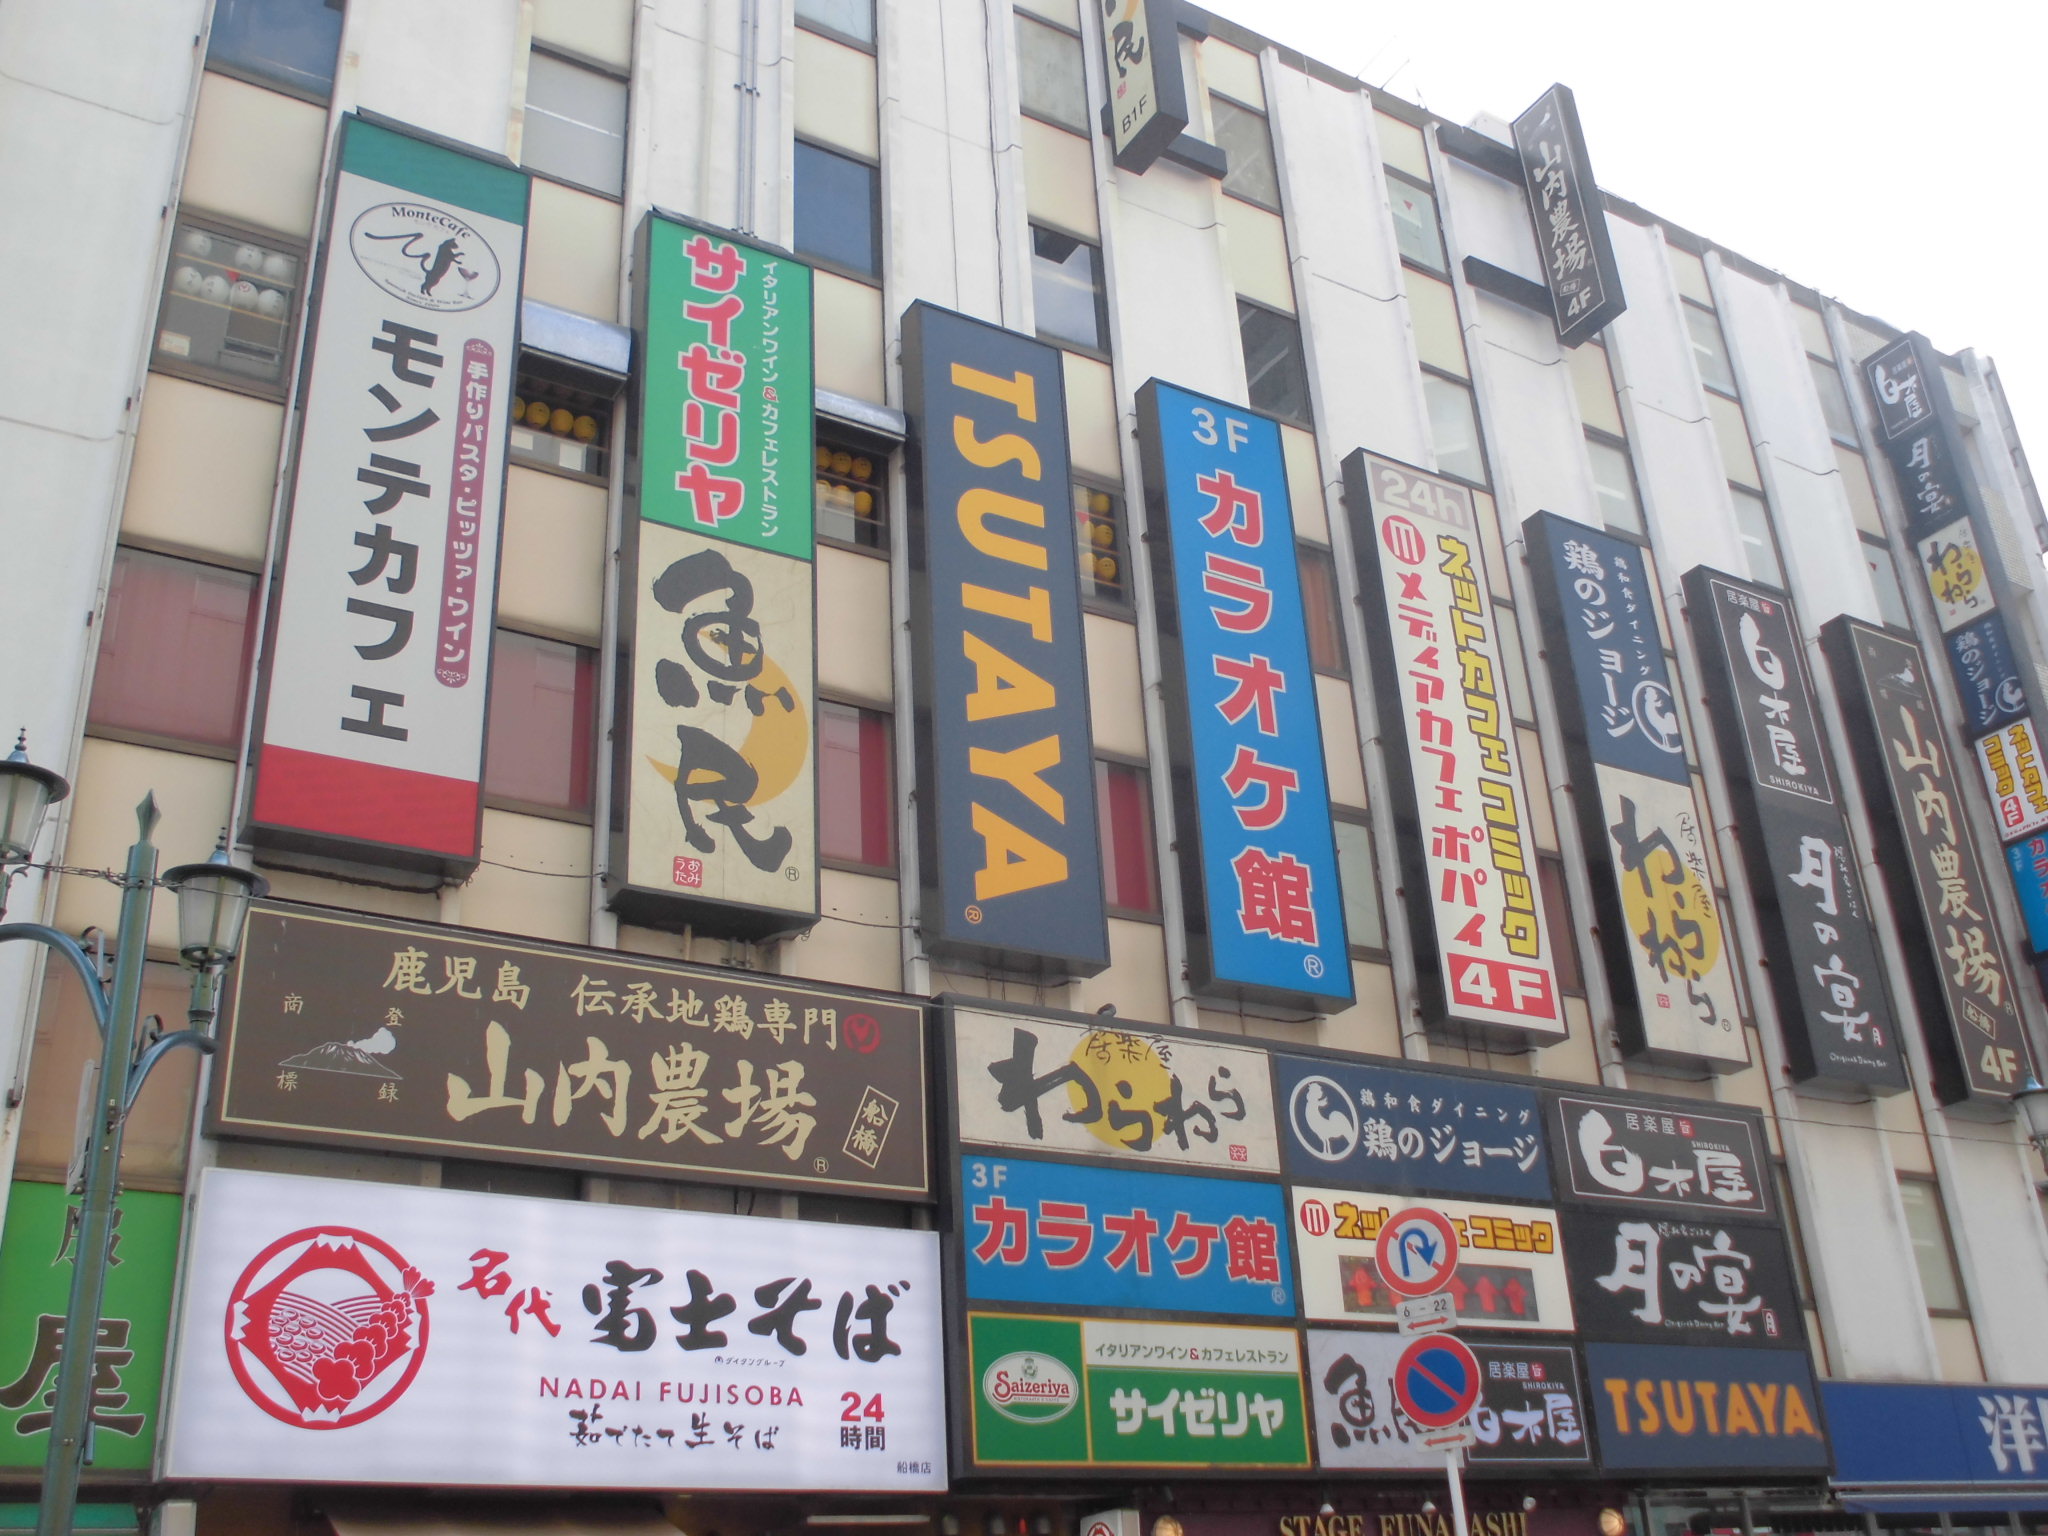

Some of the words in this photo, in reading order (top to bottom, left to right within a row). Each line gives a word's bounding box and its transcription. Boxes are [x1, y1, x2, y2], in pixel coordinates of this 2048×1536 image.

[1121, 94, 1148, 134] B1F
[391, 206, 471, 239] MonteCafe
[1533, 141, 1587, 281] 山内農場
[1567, 286, 1592, 317] 4F
[675, 233, 746, 528] サイゼリヤ
[761, 261, 780, 538] イタリアンワイン&カフェレストラン
[1875, 363, 1924, 419] 白木屋
[1190, 407, 1249, 454] 3F
[1380, 470, 1463, 528] 24h
[1906, 436, 1945, 514] 月の宴
[341, 319, 445, 742] モンテカフェ
[1926, 541, 1979, 608] わらわら
[950, 362, 1068, 900] TSUTAYA
[1562, 539, 1634, 738] 鶏のジョージ
[1613, 556, 1650, 676] 鶏和食ダイニング
[1196, 468, 1319, 947] カラオケ館
[1739, 612, 1807, 776] 白木屋
[1955, 631, 1997, 726] 鶏のジョージ
[651, 548, 797, 874] 魚民
[1396, 571, 1463, 813] メディアカフェ
[1431, 825, 1488, 948] ポパイ
[1436, 534, 1512, 777] ネットカフェ
[1477, 776, 1540, 960] コミック
[1982, 734, 2015, 798] コミック
[1769, 774, 1820, 796] SHIROKIYA
[2004, 798, 2020, 826] 4F
[1892, 704, 2002, 1007] 山内農場
[1610, 793, 1718, 1026] わらわら
[1788, 834, 1869, 1042] 月の宴
[382, 945, 531, 1011] 鹿児島
[570, 974, 838, 1052] 伝承地鶏専門
[1459, 961, 1544, 1011] 4F
[446, 1020, 819, 1161] 山内農場
[987, 1027, 1247, 1152] わらわら
[1980, 1046, 2018, 1084] 4F
[851, 1098, 889, 1157] 船橋
[1359, 1088, 1530, 1126] 鶏和食ダイニング
[1625, 1112, 1677, 1136] 居楽屋
[1362, 1117, 1539, 1173] 鶏のジョージ
[1578, 1108, 1754, 1203] 白木屋
[1690, 1140, 1731, 1151] SHIROKIYA
[971, 1162, 1008, 1189] 3F
[972, 1195, 1281, 1284] カラオケ館
[1469, 1214, 1554, 1255] コミック
[456, 1248, 562, 1339] 名代
[1595, 1222, 1762, 1335] 月の宴
[581, 1259, 911, 1364] 富士そば
[1095, 1343, 1289, 1365] イタリアンワイン&カフェレストラン
[1488, 1361, 1530, 1380] 居楽屋
[540, 1377, 642, 1402] NADAI
[659, 1381, 804, 1407] FUJISOBA
[840, 1391, 885, 1422] 24
[992, 1370, 1070, 1402] Saizeriya
[1109, 1386, 1285, 1438] サイゼリヤ
[1522, 1381, 1565, 1390] SHIROKIYA
[1603, 1377, 1817, 1437] TSUTAYA
[568, 1403, 780, 1450] 茹でたて生そば
[840, 1425, 886, 1451] 時間
[1468, 1391, 1582, 1445] 白木屋
[1977, 1394, 2048, 1473] 洋
[896, 1461, 933, 1474] 船橋店
[1279, 1514, 1365, 1536] STAGE
[1378, 1511, 1529, 1536] FUNAASHI
